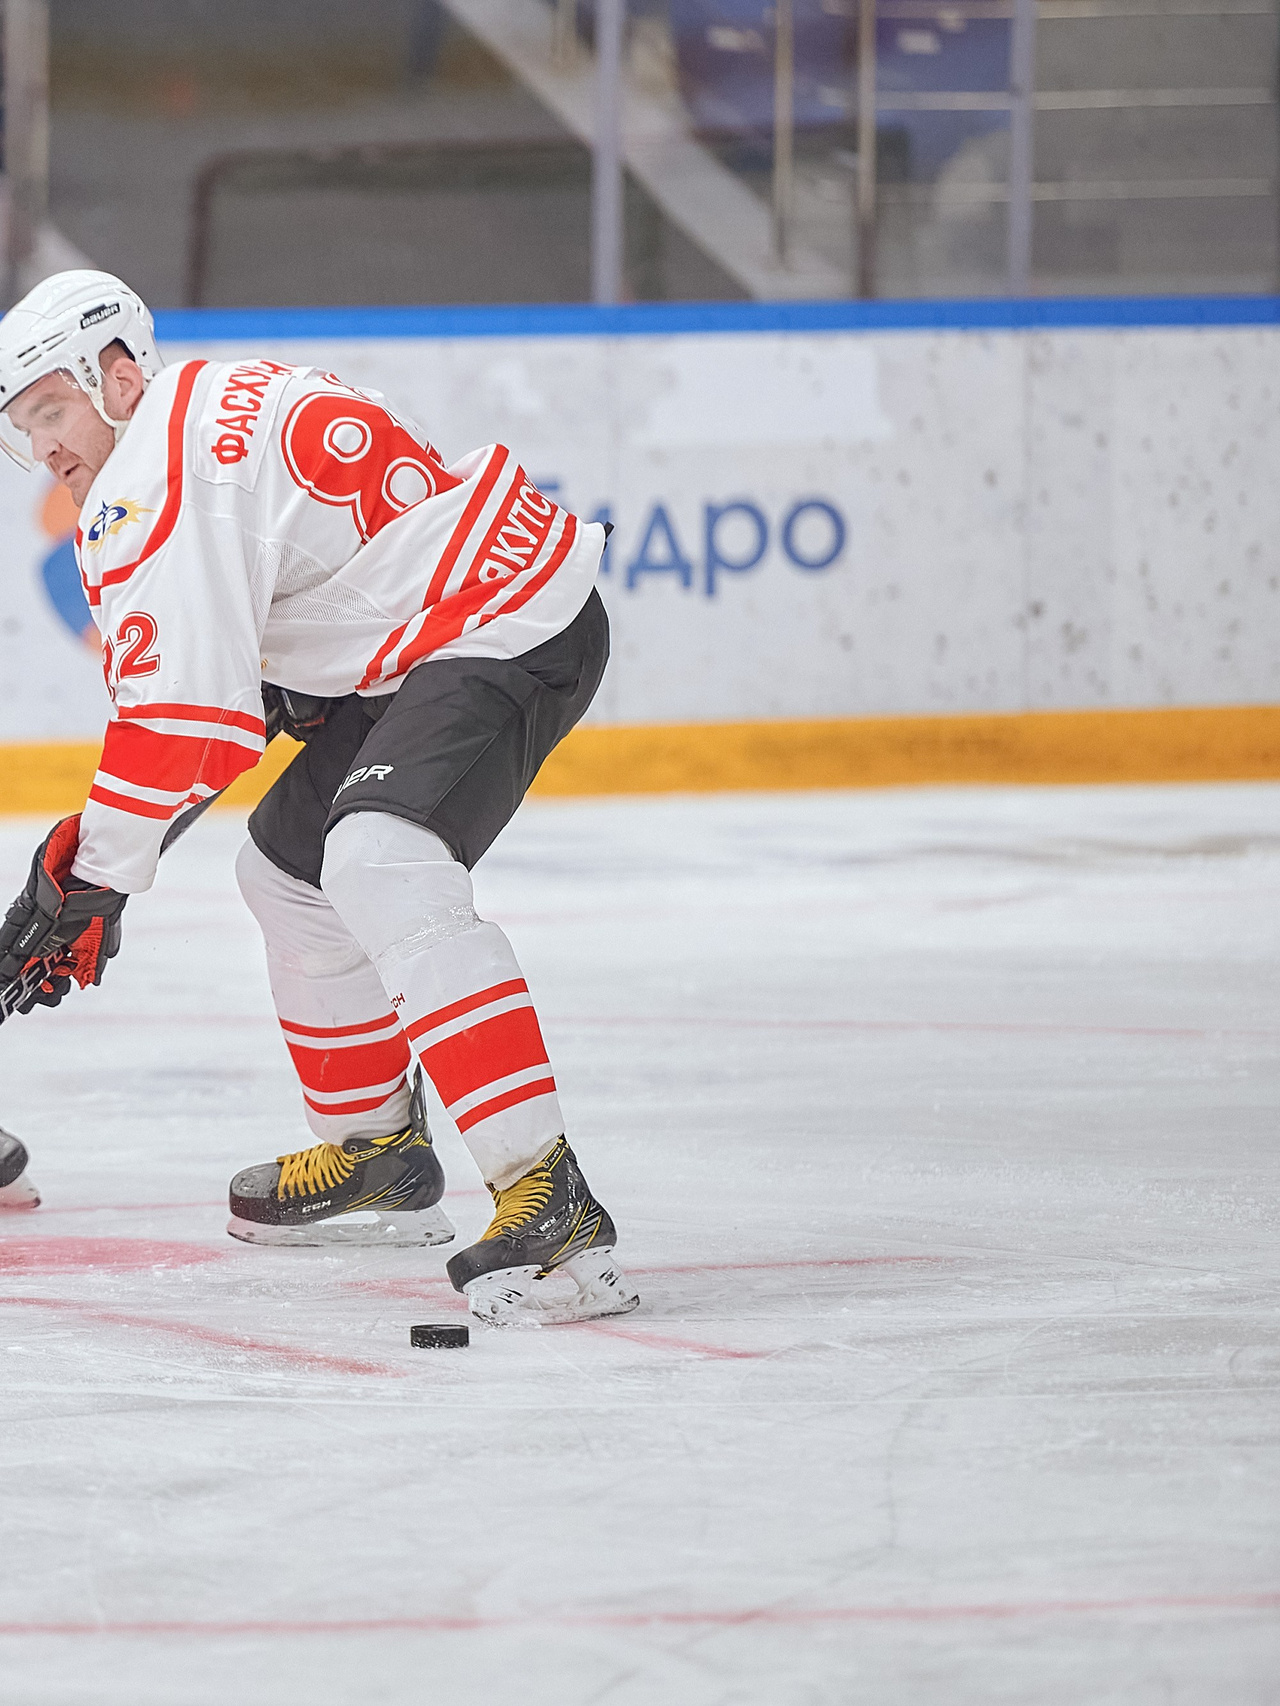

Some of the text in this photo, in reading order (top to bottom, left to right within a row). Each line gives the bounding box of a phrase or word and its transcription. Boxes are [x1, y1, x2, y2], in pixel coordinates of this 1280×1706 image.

[211, 360, 292, 465] ФАСХУ
[281, 372, 467, 545] 8
[478, 474, 556, 584] ЯКУТС
